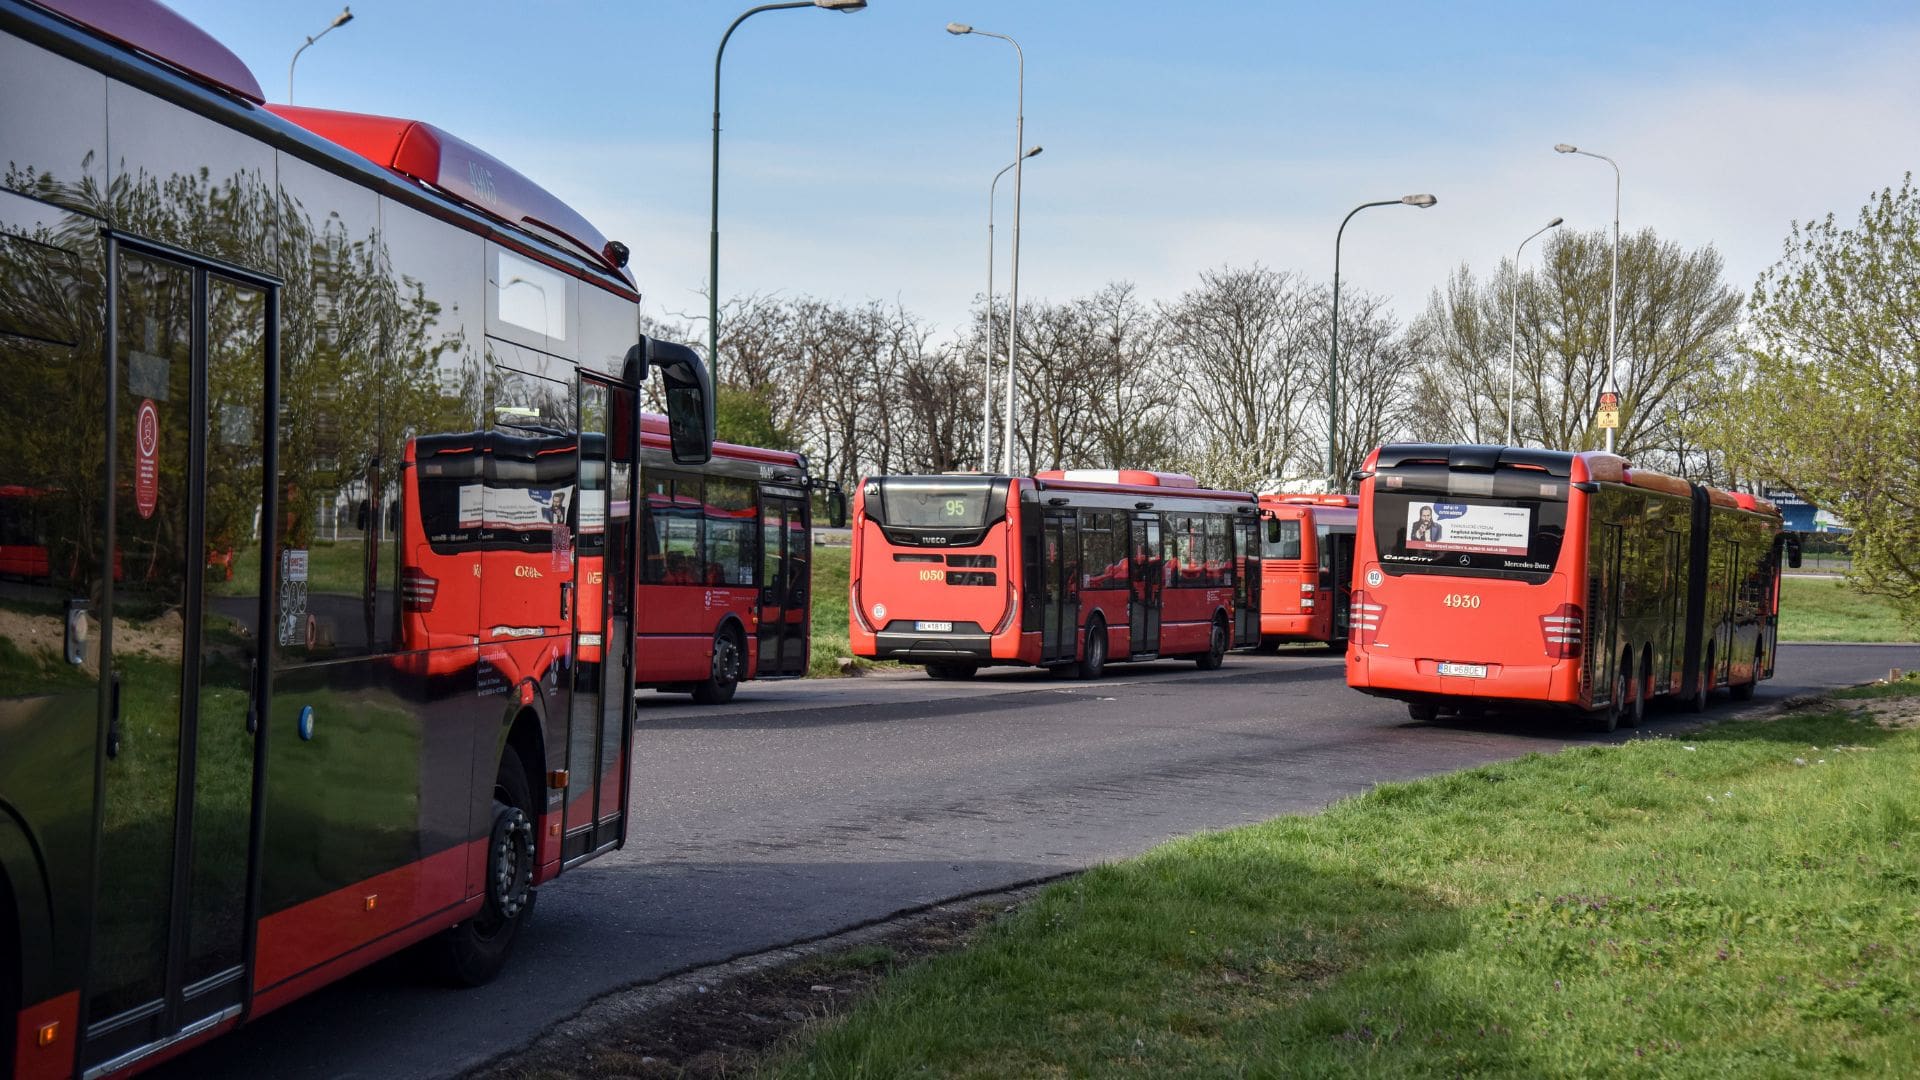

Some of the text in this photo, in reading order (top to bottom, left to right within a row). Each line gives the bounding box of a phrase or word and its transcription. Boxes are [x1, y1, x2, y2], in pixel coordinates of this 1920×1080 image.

[946, 500, 965, 516] 95
[922, 536, 947, 544] IVECO
[1504, 560, 1551, 570] Mercedes-Benz
[920, 570, 944, 581] 1050
[1370, 572, 1380, 581] 80
[1443, 593, 1481, 609] 4930
